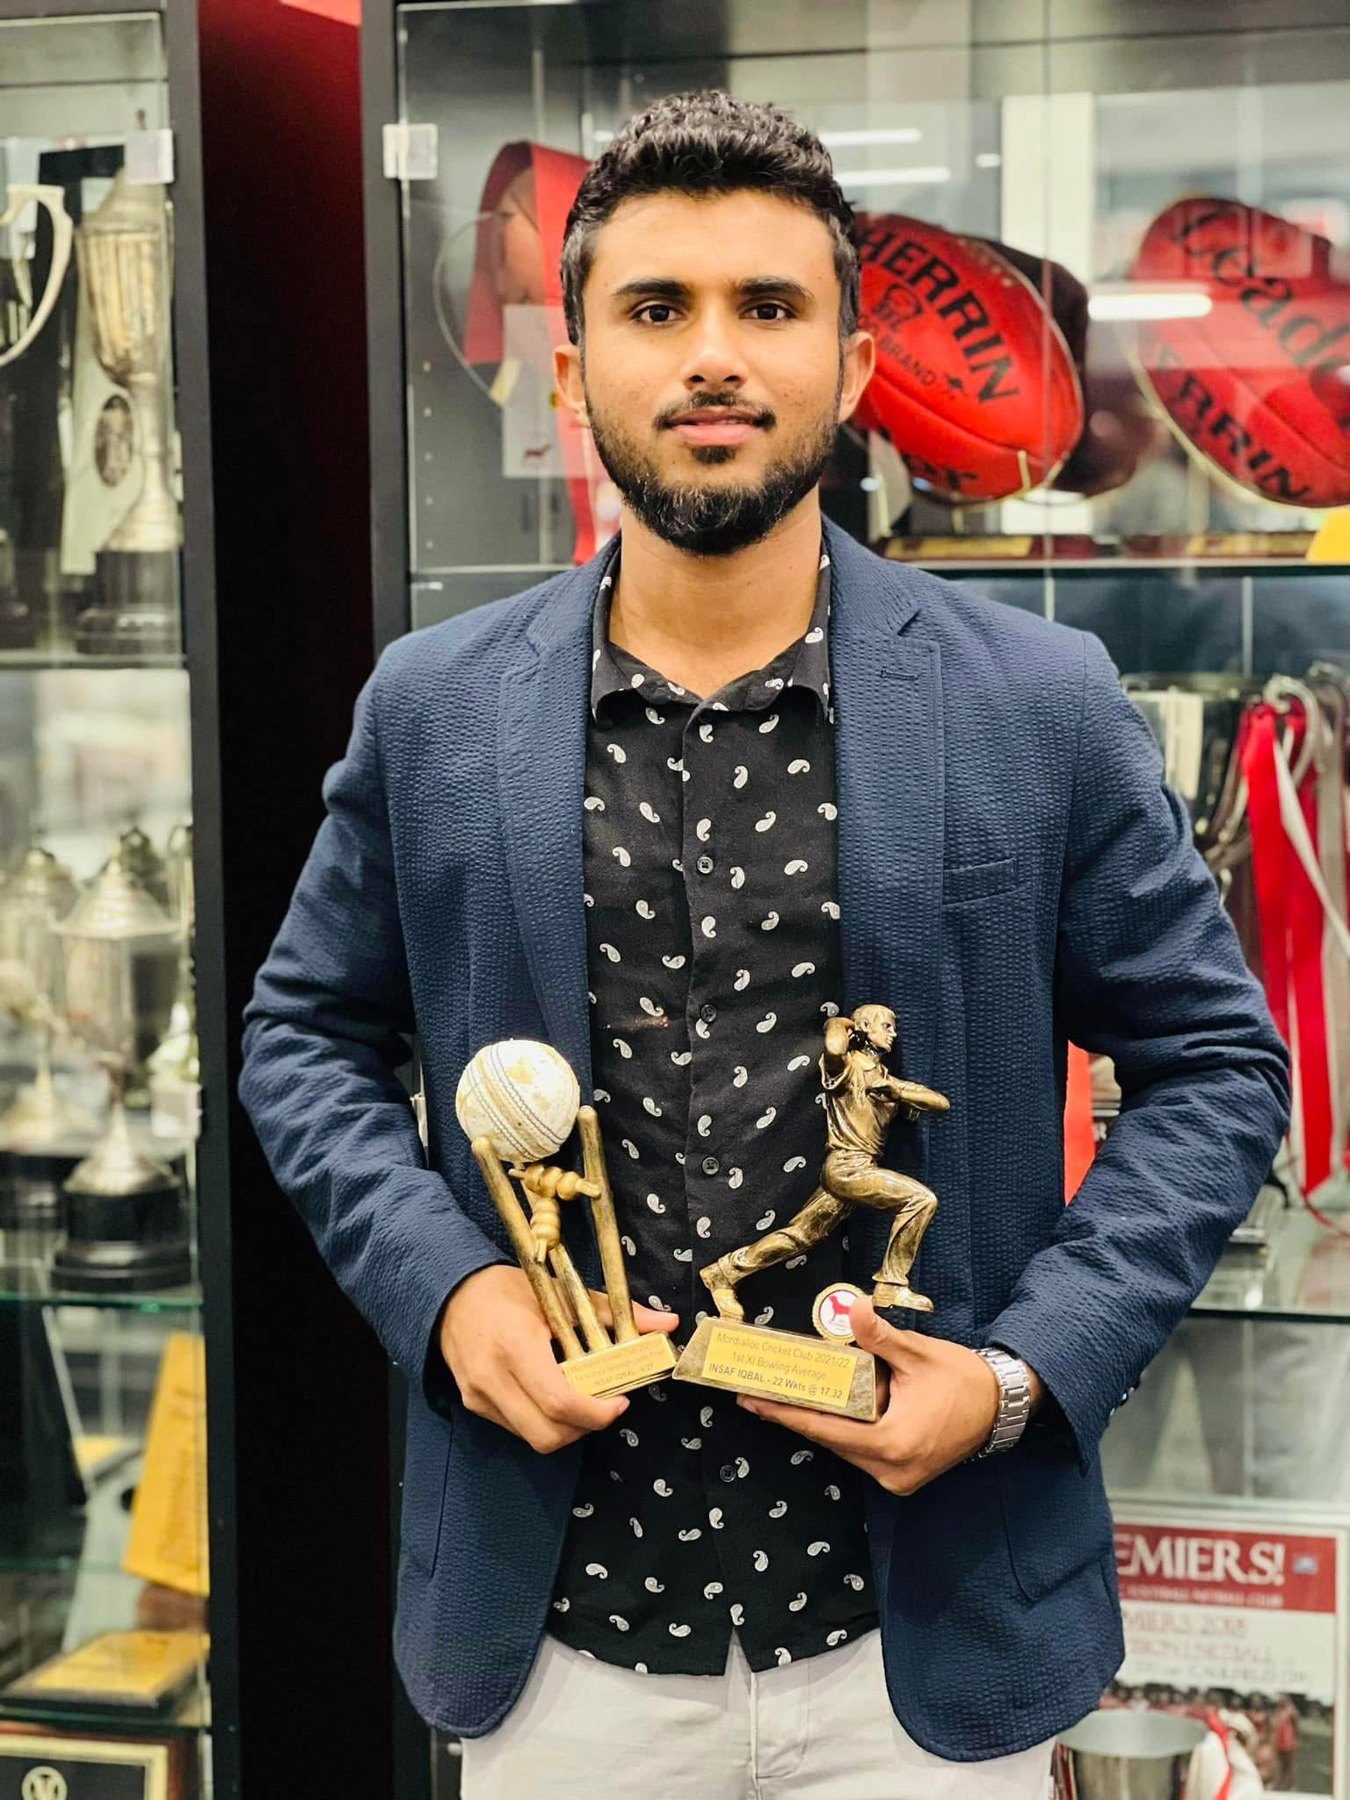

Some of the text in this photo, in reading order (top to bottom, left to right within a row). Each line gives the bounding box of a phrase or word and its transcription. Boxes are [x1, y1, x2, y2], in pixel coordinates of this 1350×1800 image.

[731, 1351, 827, 1381] 1st XI Bowling Average
[761, 1341, 791, 1356] Cricket
[792, 1347, 813, 1360] Club
[814, 1352, 850, 1368] 2021/22
[708, 1362, 736, 1376] INSAF
[737, 1368, 765, 1382] IQBAL
[772, 1377, 782, 1386] 22
[784, 1379, 806, 1391] Wkts
[807, 1384, 817, 1396] @
[820, 1386, 843, 1398] 17.32
